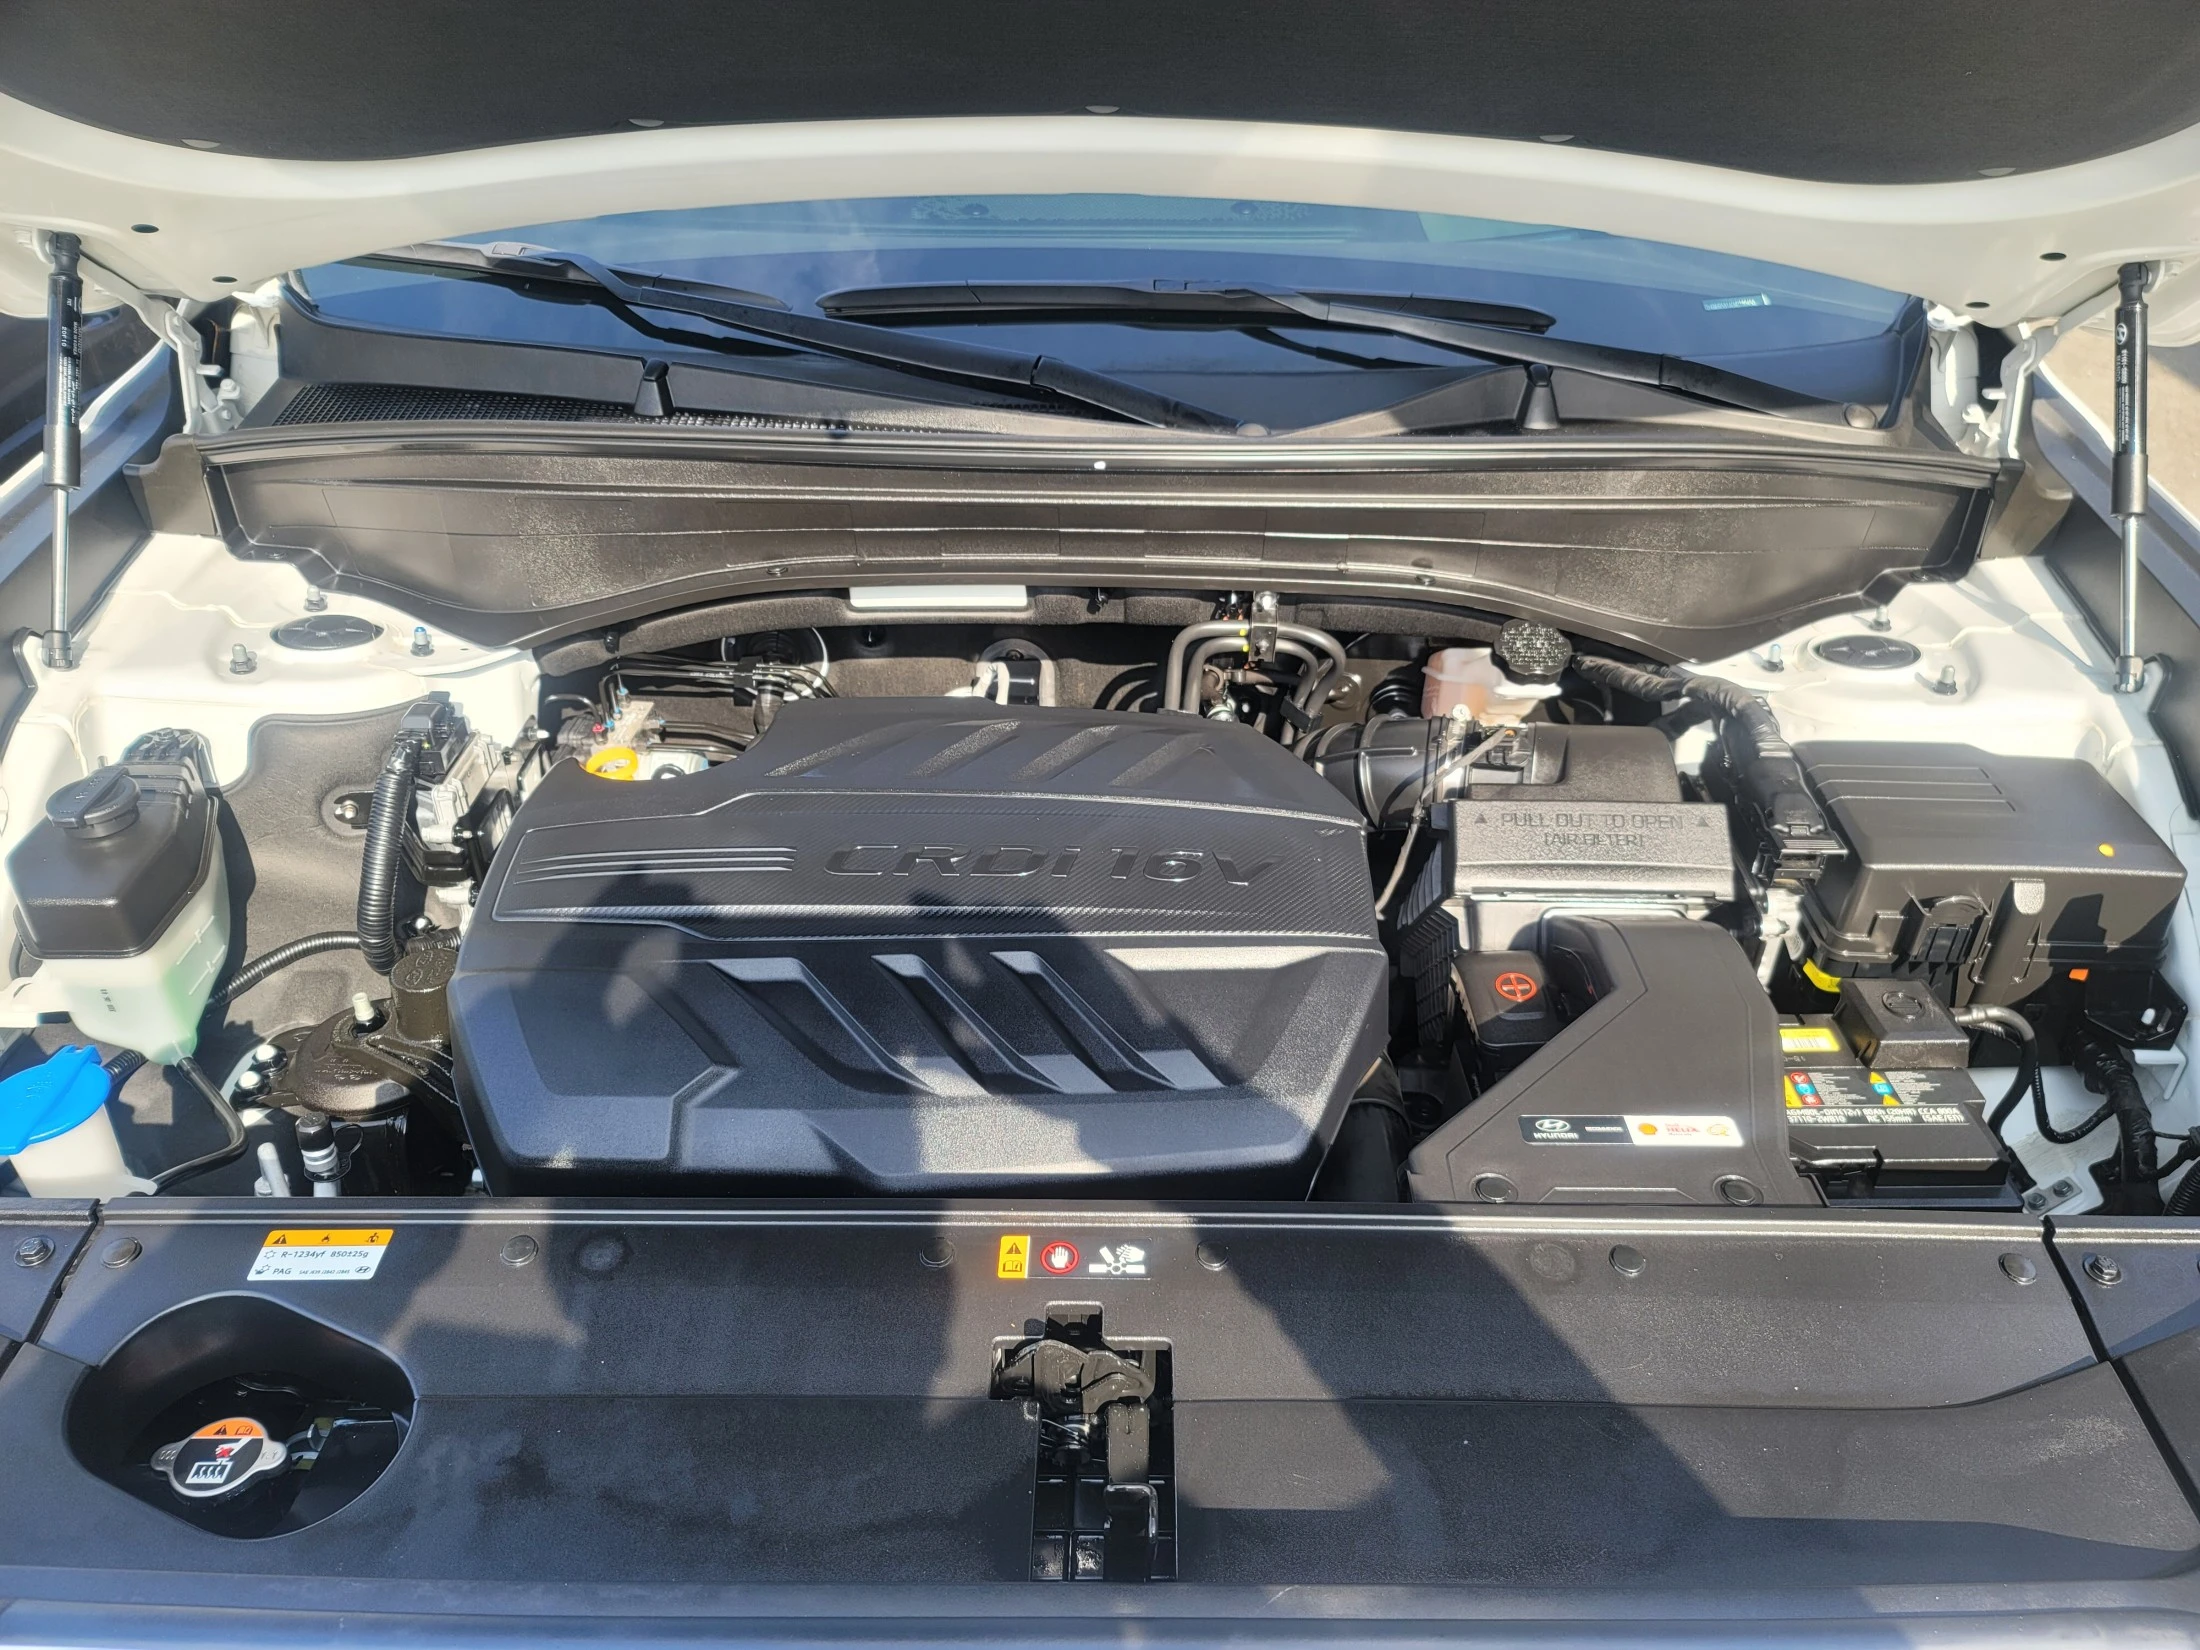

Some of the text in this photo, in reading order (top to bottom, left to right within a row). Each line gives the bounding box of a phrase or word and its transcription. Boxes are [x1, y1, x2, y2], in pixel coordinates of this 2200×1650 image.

[1501, 812, 1684, 830] PULL OUT TO OPEN
[1110, 844, 1284, 886] 16V
[1533, 1132, 1580, 1140] HYUNDAI
[281, 1250, 369, 1259] R-1234yf 850±25g
[272, 1267, 293, 1275] PAG
